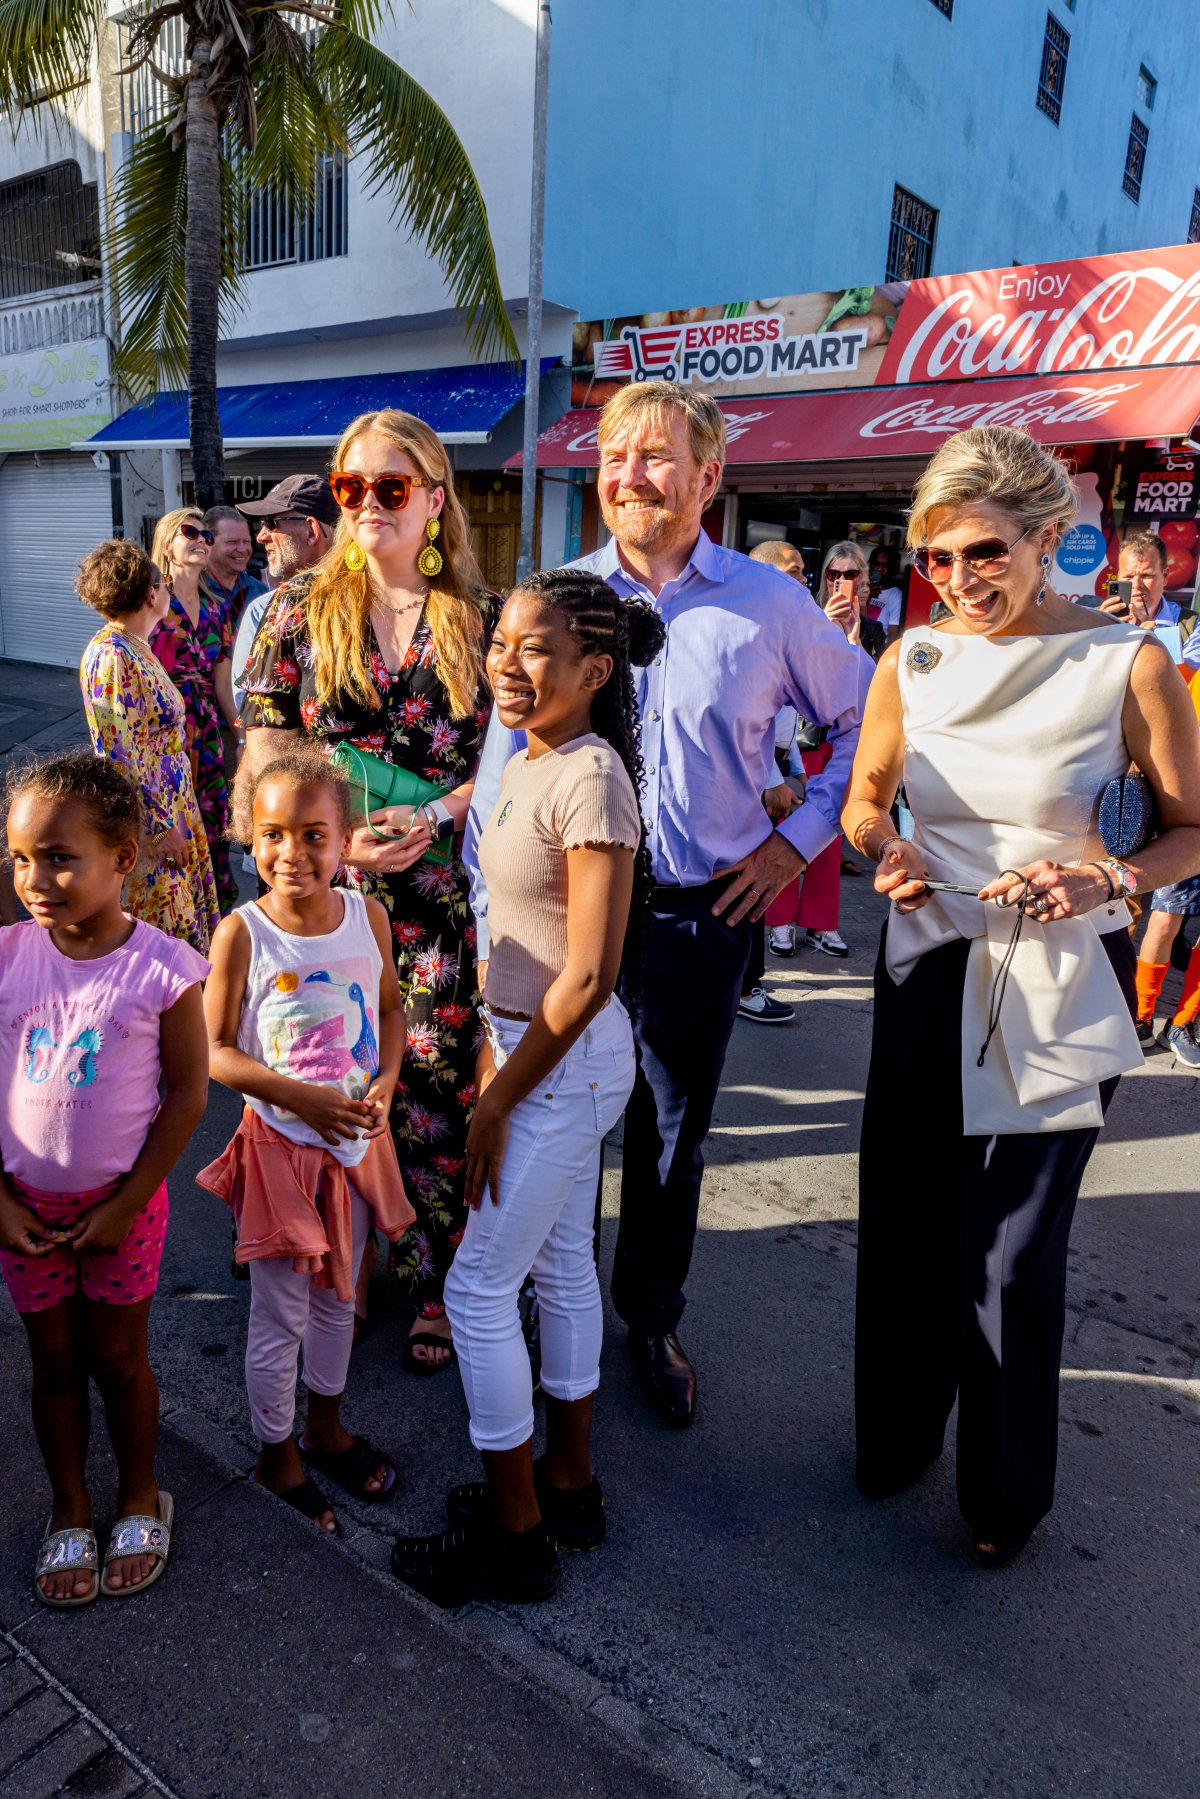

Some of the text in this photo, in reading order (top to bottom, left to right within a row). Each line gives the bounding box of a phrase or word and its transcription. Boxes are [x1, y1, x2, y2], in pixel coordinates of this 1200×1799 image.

[999, 271, 1071, 301] Enjoy
[685, 318, 780, 349] EXPRESS
[683, 334, 863, 379] FOOD MART
[28, 349, 99, 397] Dolls
[2, 407, 17, 418] SHOP
[19, 405, 31, 416] FOR
[33, 402, 52, 415] SMART
[1138, 471, 1195, 483] EXPRESS
[1136, 481, 1194, 497] FOOD
[1133, 497, 1192, 513] MART
[1063, 556, 1094, 565] chippie
[18, 1003, 46, 1023] ENJOY
[52, 1001, 57, 1009] A
[108, 1016, 124, 1032] DAY
[25, 1097, 92, 1110] UNDER WATER
